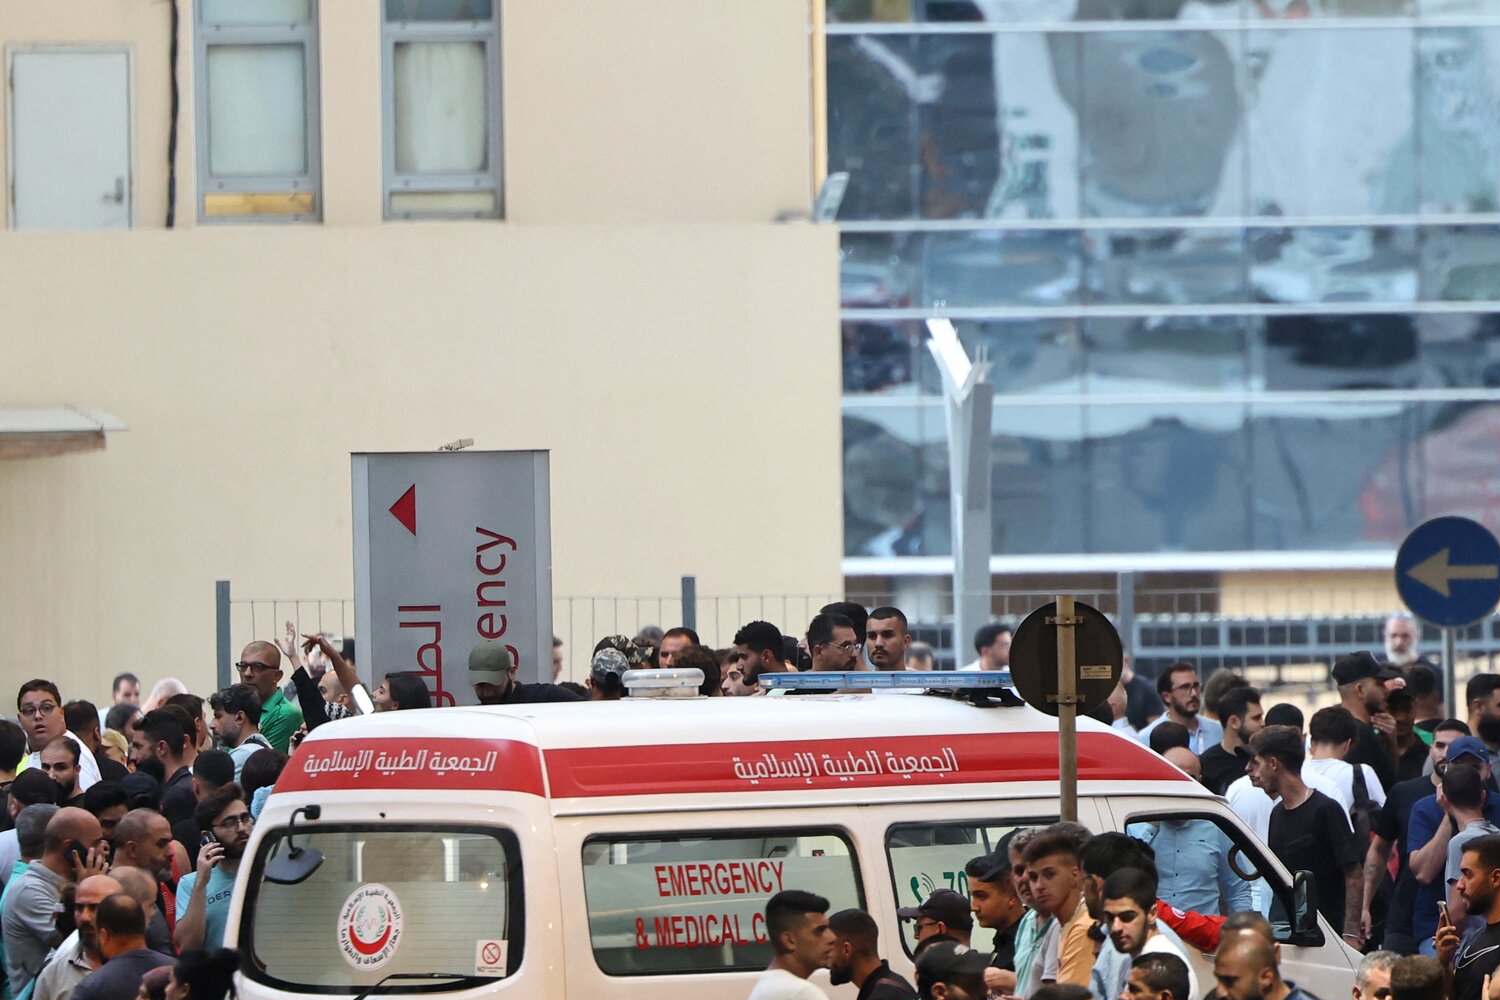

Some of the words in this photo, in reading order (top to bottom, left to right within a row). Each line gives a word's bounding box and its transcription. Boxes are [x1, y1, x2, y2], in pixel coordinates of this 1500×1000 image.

[476, 527, 518, 671] ency
[303, 750, 374, 778] الإسلامية
[375, 750, 428, 775] الطبية
[429, 751, 498, 776] الجمعية
[732, 752, 820, 784] الإسلامية
[821, 750, 884, 781] الطبية
[885, 747, 960, 778] الجمعية
[654, 861, 784, 897] EMERGENCY
[635, 917, 650, 950] &
[654, 914, 749, 948] MEDICAL
